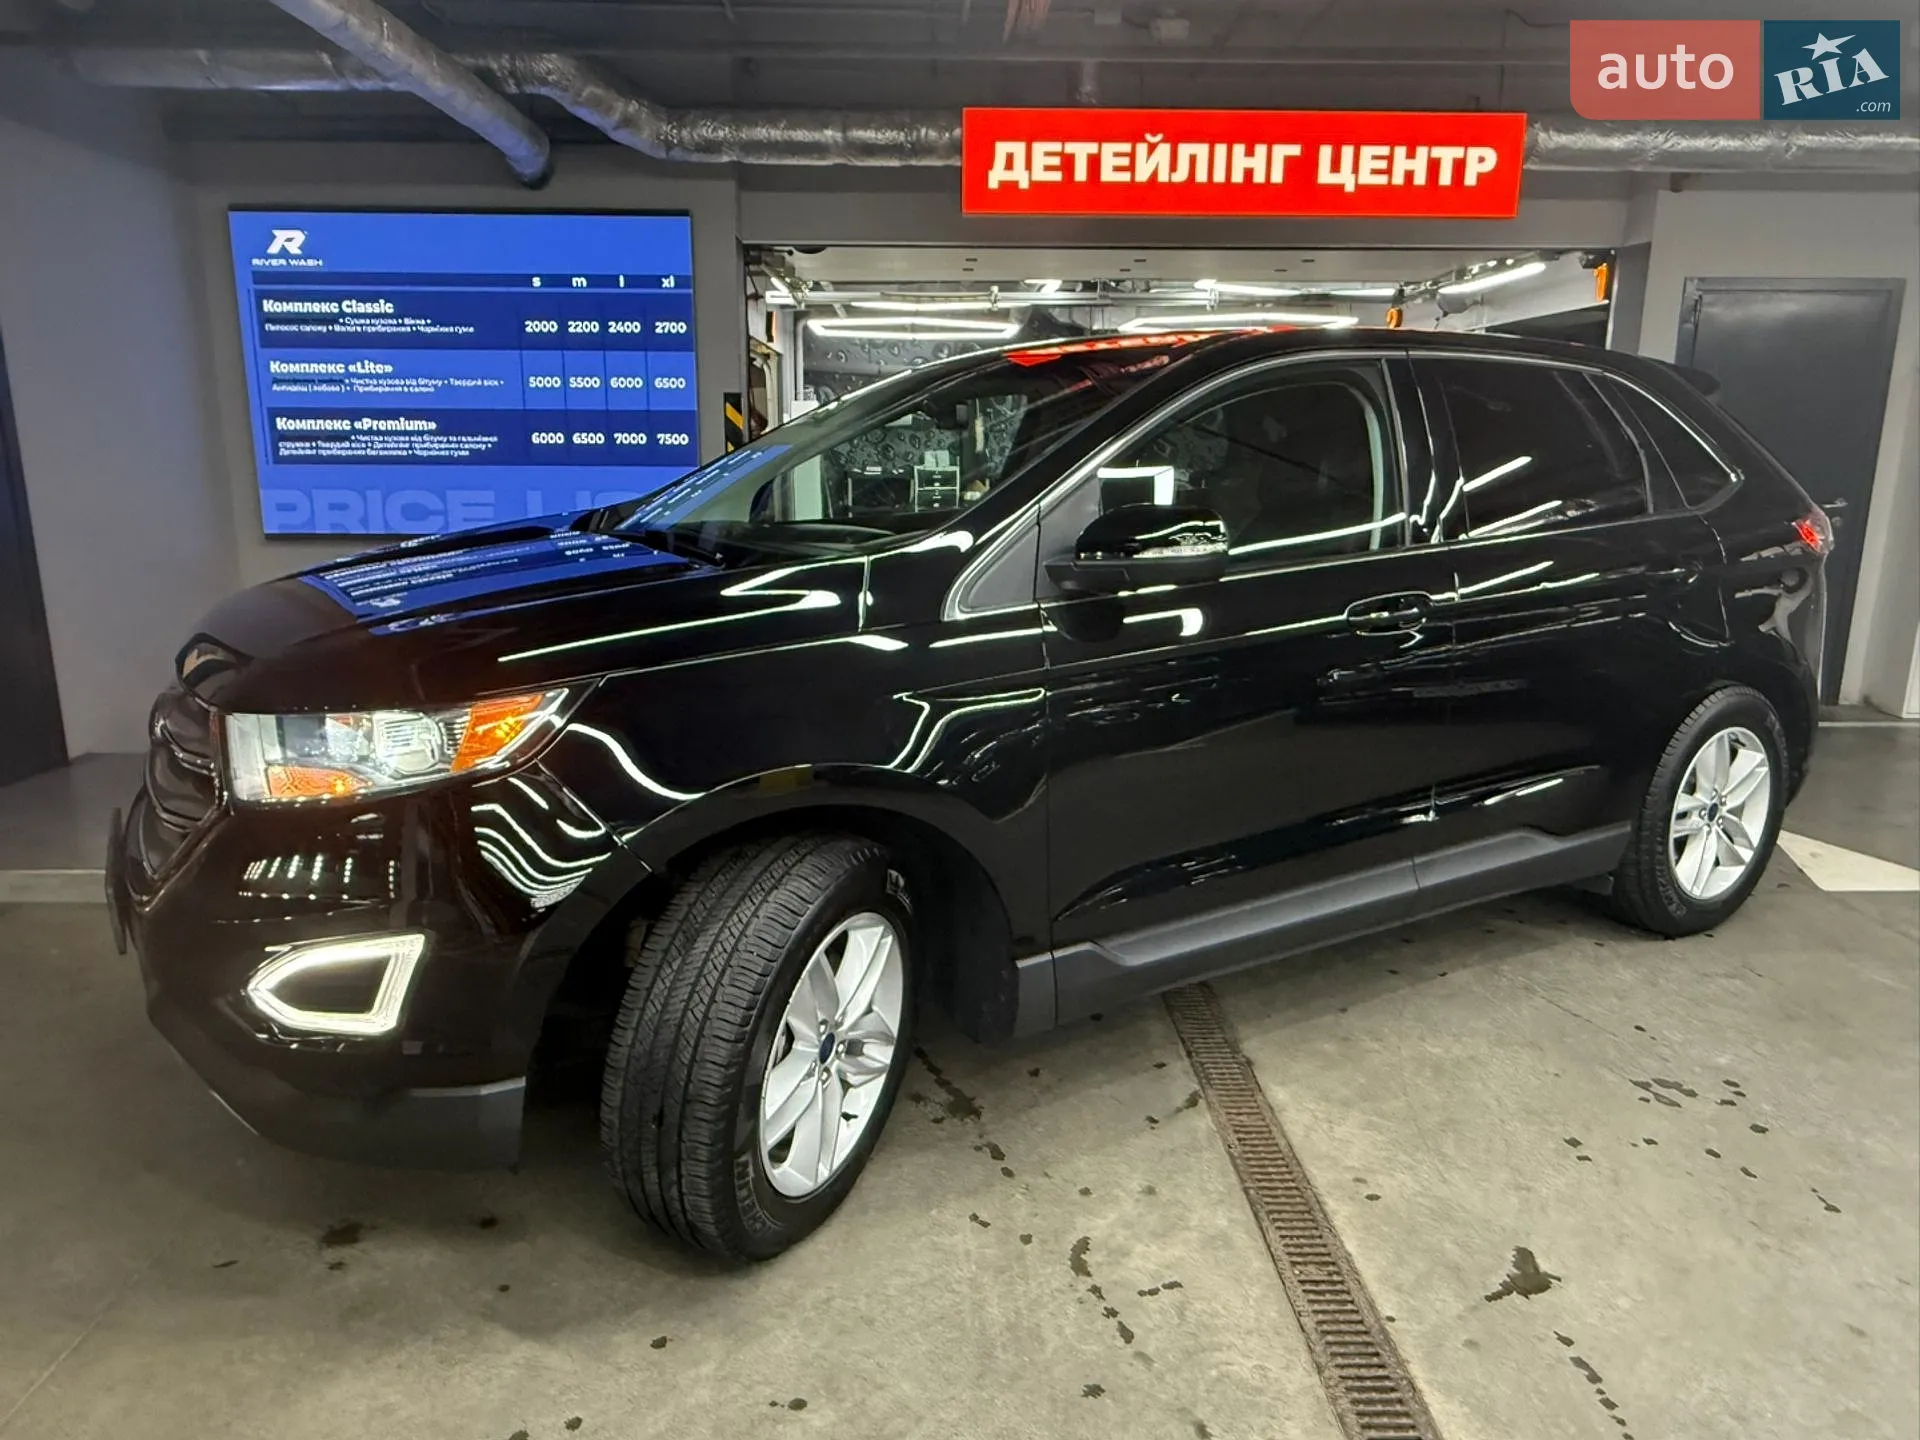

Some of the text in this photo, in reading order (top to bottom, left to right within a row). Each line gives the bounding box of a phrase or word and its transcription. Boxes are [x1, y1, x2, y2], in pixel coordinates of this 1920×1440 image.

[988, 133, 1498, 192] ДЕТЕЙЛІНГ ЦЕНТР
[252, 258, 323, 267] RIVER WASH
[571, 277, 588, 288] m
[661, 274, 675, 288] xl
[262, 298, 394, 314] Комплекс Classic
[525, 320, 688, 334] 2000 2200 2400 2700
[269, 359, 393, 374] Комплекс «Lite»
[529, 375, 687, 390] 5000 5500 6000 6500
[275, 416, 438, 431] Комплекс «Premium»
[531, 431, 689, 446] 6000 6500 7000 7500
[262, 489, 496, 534] PRICE
